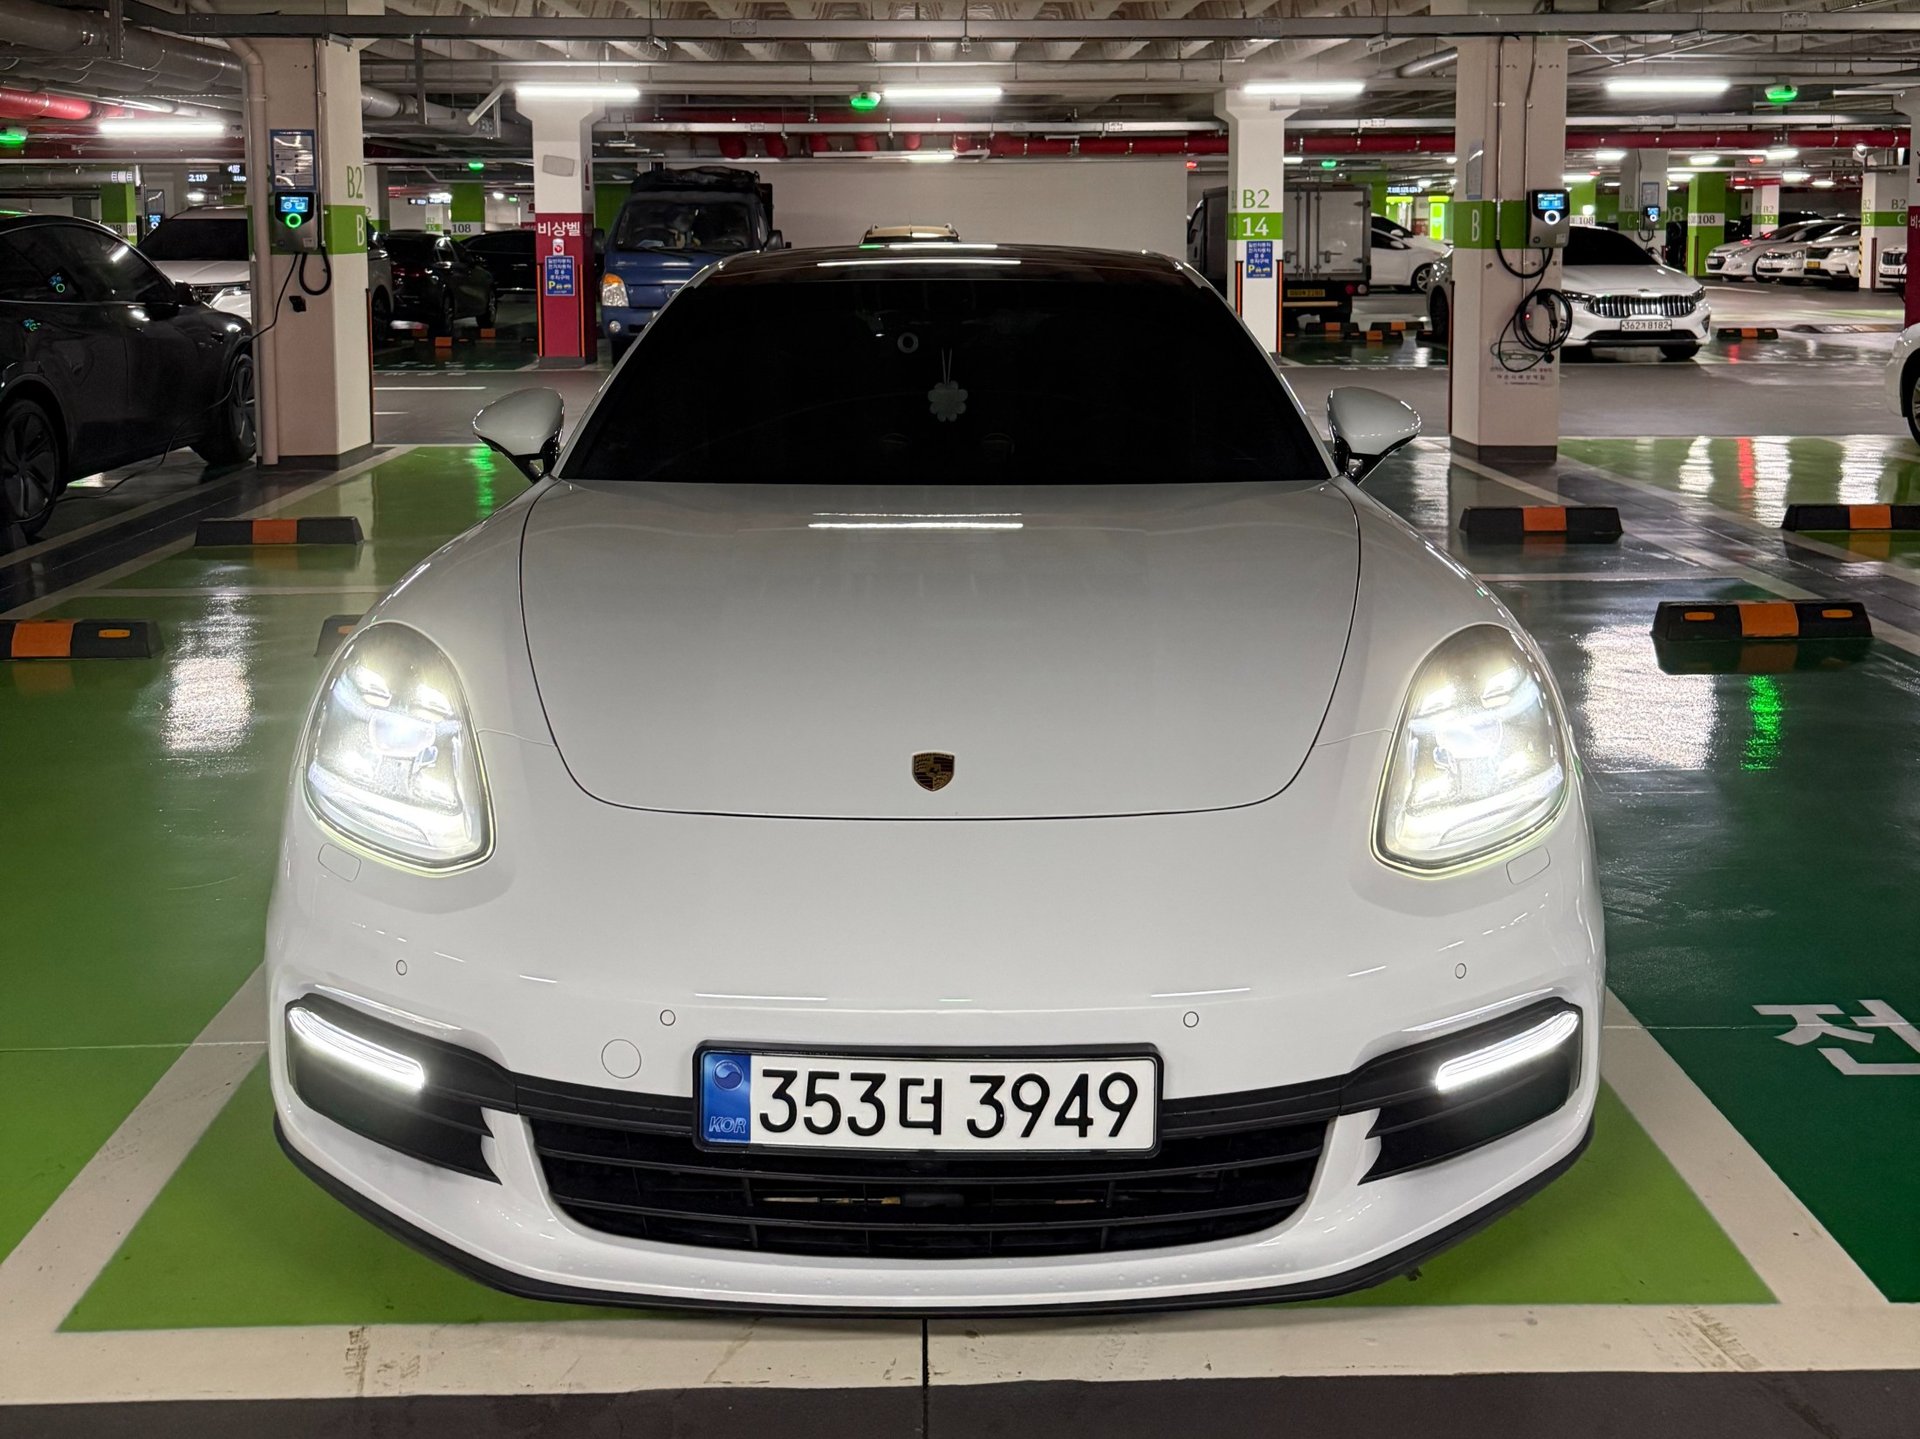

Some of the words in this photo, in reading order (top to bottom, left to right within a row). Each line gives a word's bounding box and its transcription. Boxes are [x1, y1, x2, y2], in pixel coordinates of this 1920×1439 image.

[346, 166, 363, 198] B2
[1242, 188, 1270, 209] B2
[1763, 205, 1774, 213] B2
[1863, 199, 1871, 210] B2
[1892, 199, 1906, 210] B2
[1579, 216, 1594, 225] 108
[1698, 214, 1716, 224] 108
[1764, 216, 1774, 224] 12
[1897, 214, 1906, 225] C
[1911, 214, 1920, 230] 비
[356, 214, 365, 246] B
[452, 223, 472, 234] 108
[537, 221, 581, 237] 비상벨
[1242, 216, 1270, 237] 14
[1471, 208, 1480, 242] B
[1248, 264, 1256, 273] P
[548, 280, 556, 290] P
[1647, 321, 1668, 330] 8182
[759, 1068, 942, 1136] 353더
[966, 1072, 1138, 1138] 3949
[708, 1116, 747, 1134] KOR
